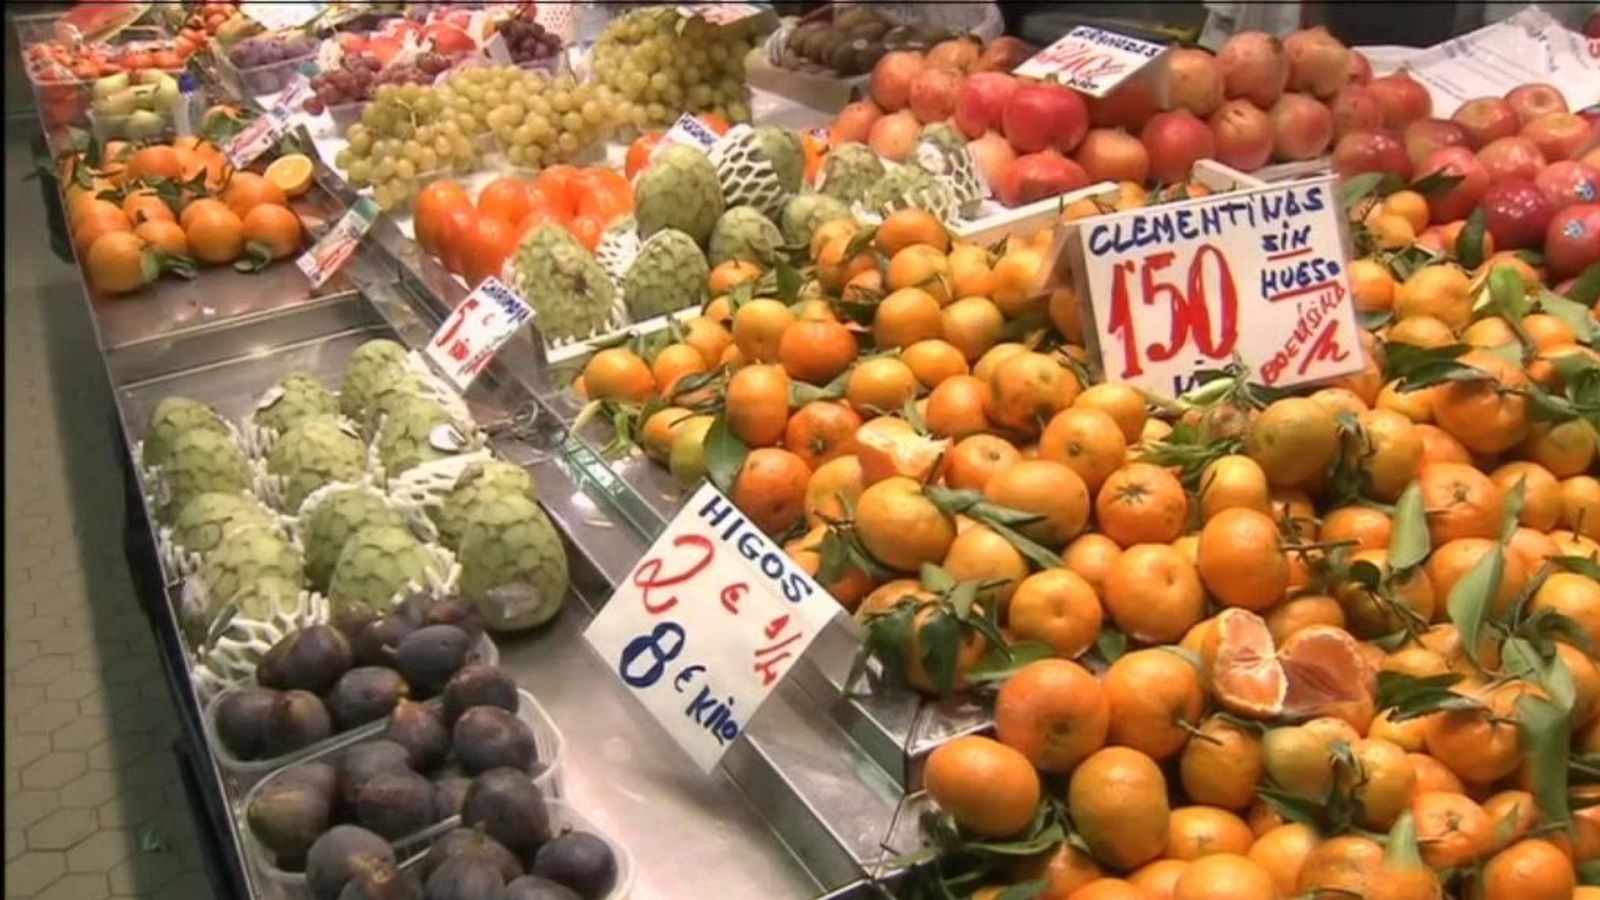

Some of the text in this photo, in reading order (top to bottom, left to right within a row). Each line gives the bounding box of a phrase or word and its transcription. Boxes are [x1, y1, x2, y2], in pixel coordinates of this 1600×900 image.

[1089, 187, 1324, 256] CLEMENTINAS
[1260, 257, 1341, 299] HUESO
[633, 533, 716, 615] 2
[698, 495, 814, 604] HIGOS
[619, 621, 686, 689] 8
